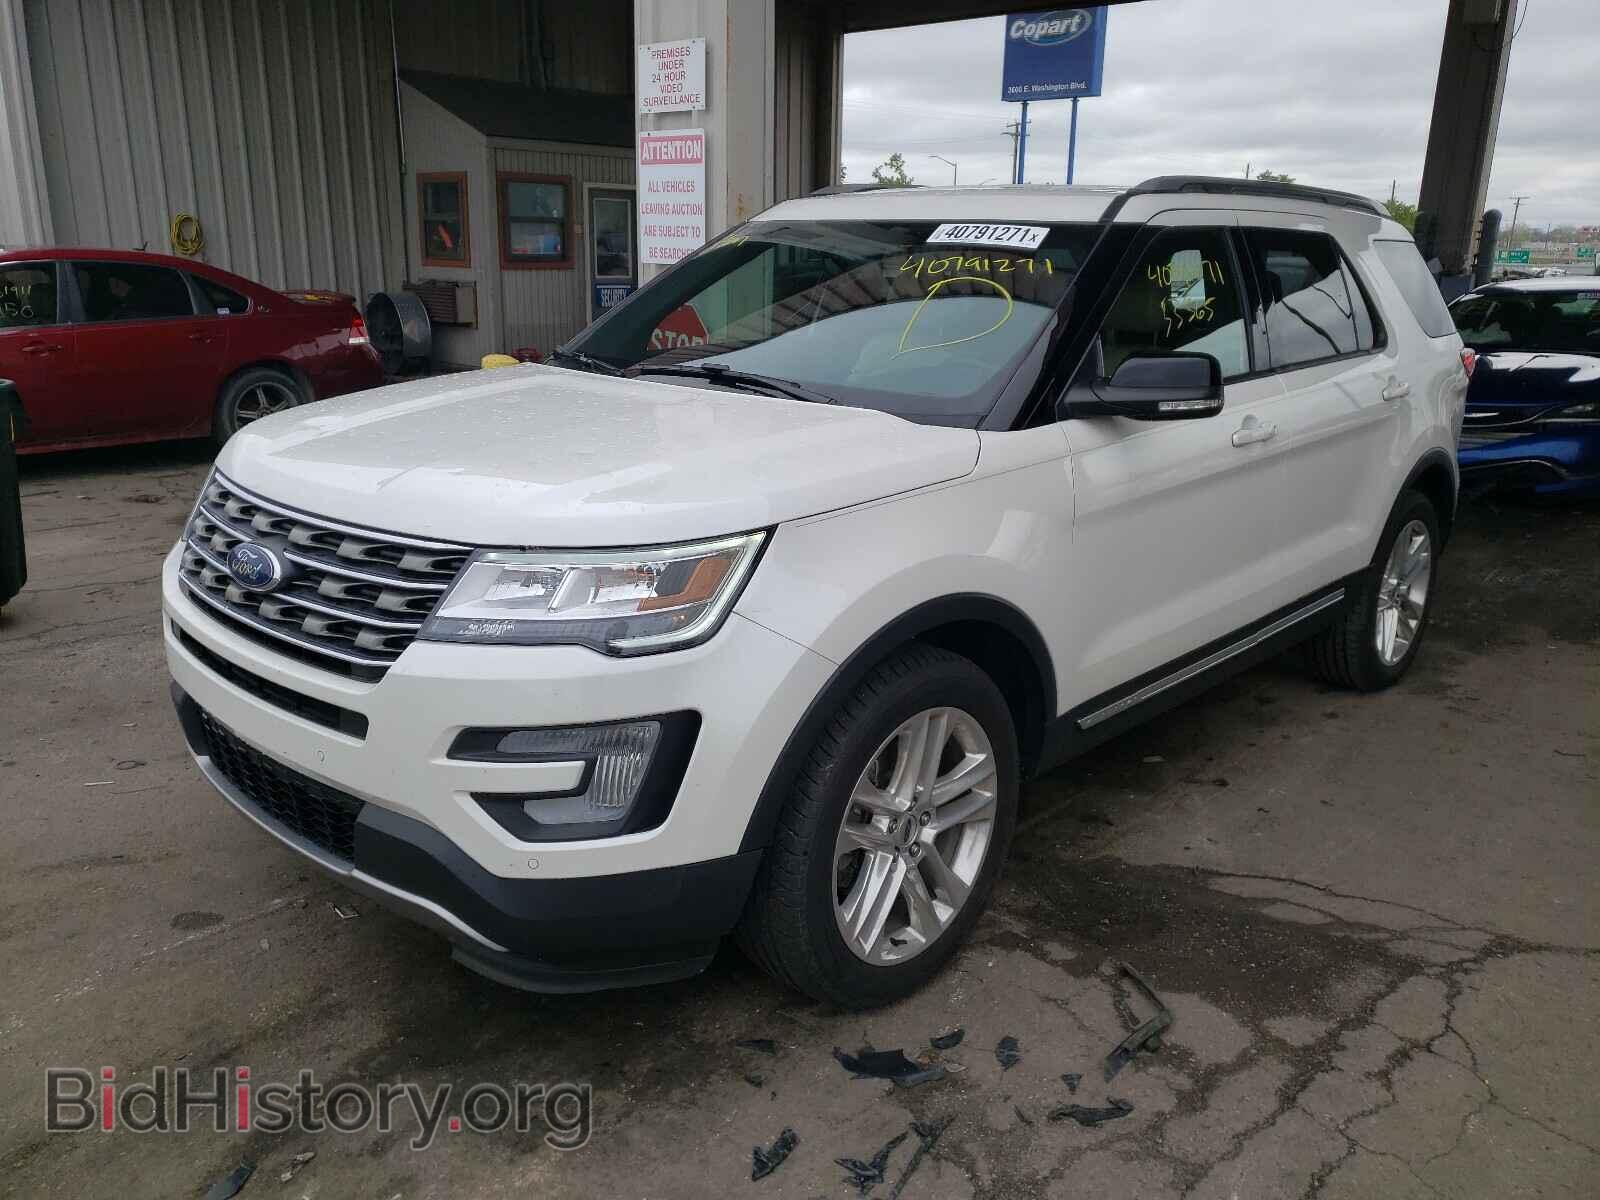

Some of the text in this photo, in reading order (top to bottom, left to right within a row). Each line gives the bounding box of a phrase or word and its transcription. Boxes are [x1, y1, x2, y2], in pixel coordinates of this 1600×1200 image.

[1010, 14, 1082, 41] Copart
[652, 46, 691, 59] PREMISES
[658, 60, 684, 71] UNDER
[651, 70, 686, 83] 24 HOUR
[660, 83, 683, 94] VIDEO
[643, 93, 701, 107] SURVEILLANCE
[642, 139, 701, 161] ATTENTION
[648, 179, 696, 193] ALL VEHICLES
[641, 202, 703, 216] LEAVING AUCTION
[643, 224, 701, 239] ARE SUBJECT TO
[648, 246, 659, 258] BE
[232, 548, 263, 580] Ford
